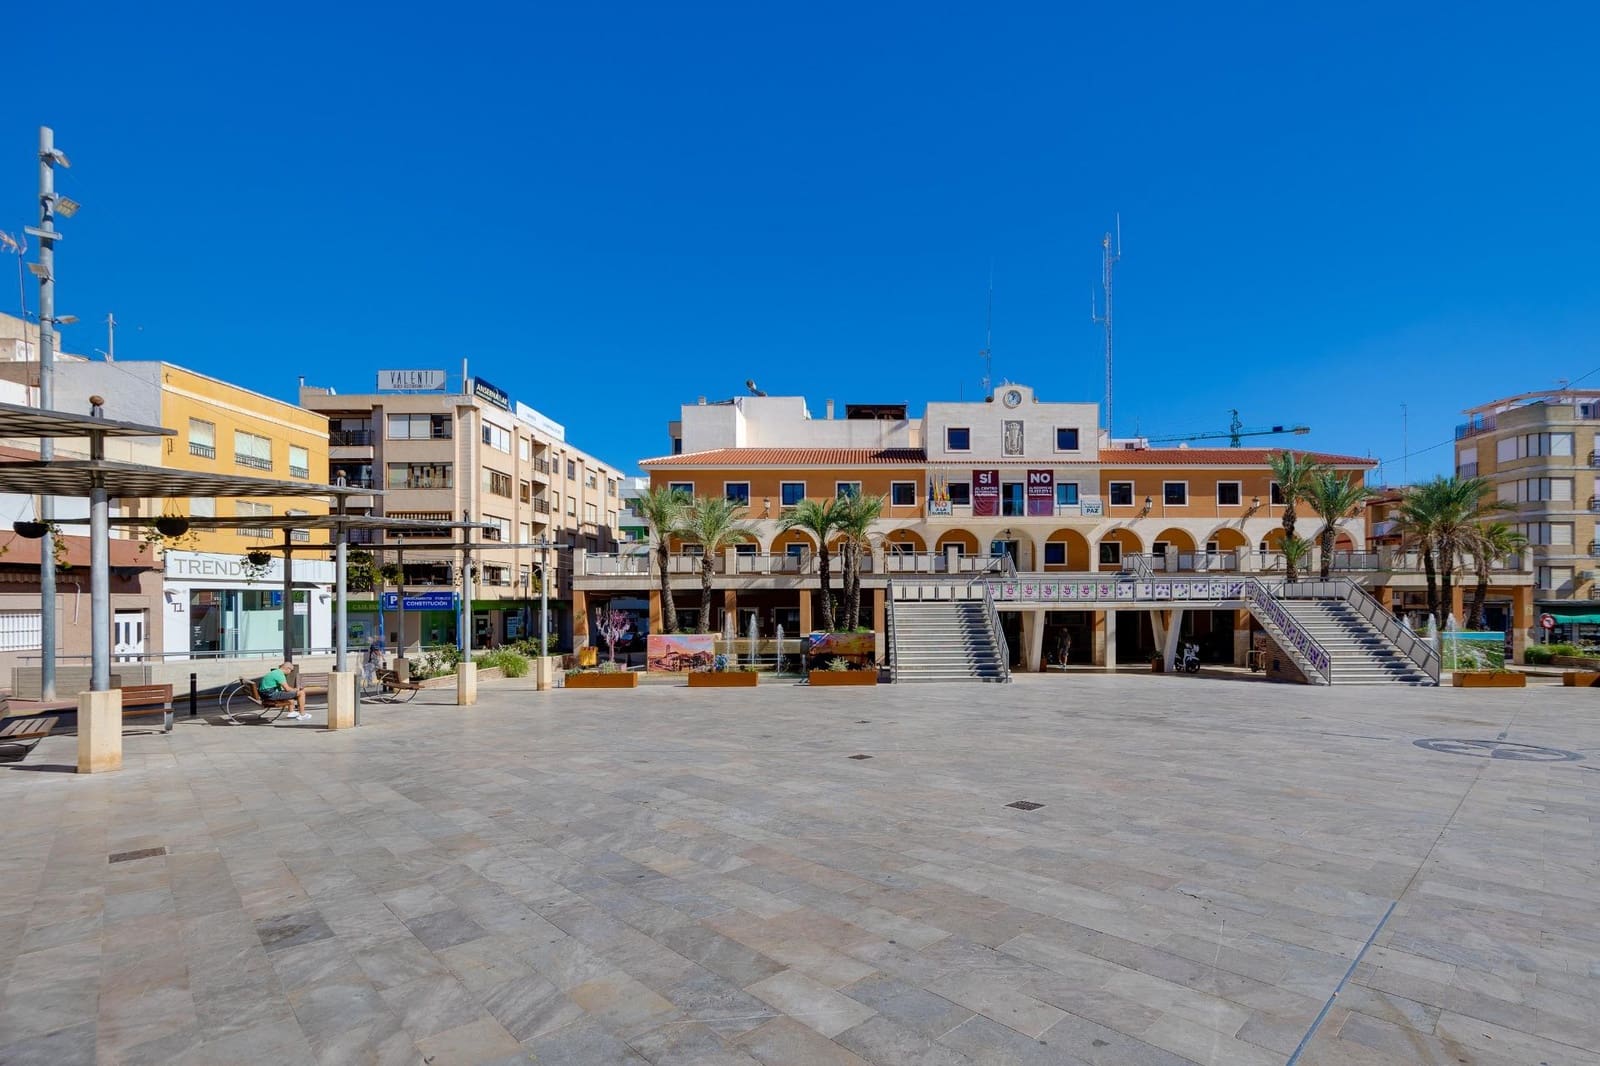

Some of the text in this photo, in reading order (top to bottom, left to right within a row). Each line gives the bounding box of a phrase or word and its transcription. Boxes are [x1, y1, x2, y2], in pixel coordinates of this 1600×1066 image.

[390, 371, 434, 385] VALENTI
[979, 471, 993, 484] SÍ
[1030, 472, 1050, 484] NO
[390, 596, 398, 605] P
